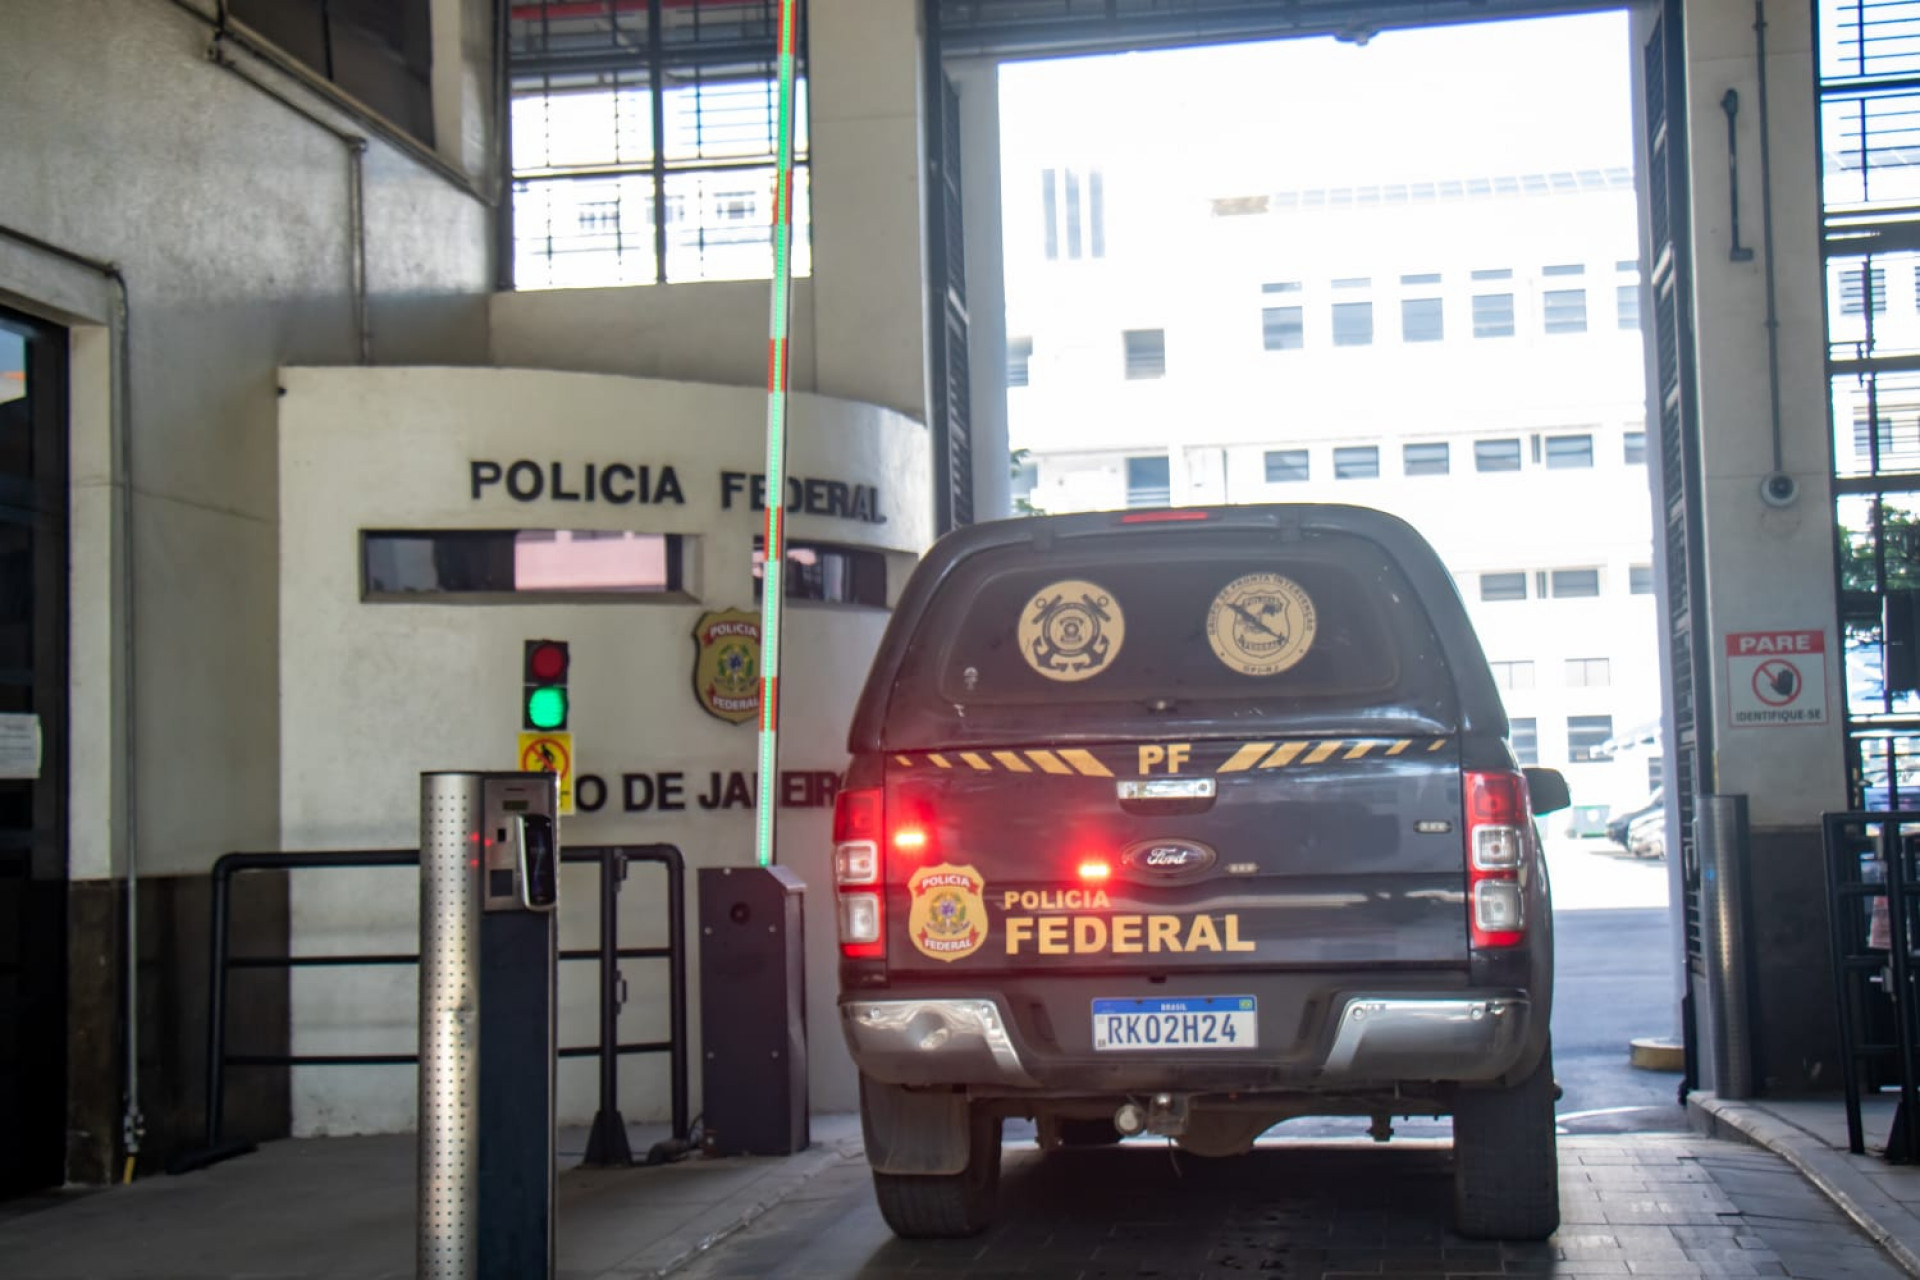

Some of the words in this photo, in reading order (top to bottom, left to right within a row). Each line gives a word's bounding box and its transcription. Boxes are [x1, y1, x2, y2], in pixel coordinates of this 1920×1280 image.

[470, 460, 686, 504] POLICIA
[1739, 634, 1811, 653] PARE
[1736, 708, 1822, 722] IDENTIFIQUE-SE
[1138, 743, 1191, 775] PF
[622, 772, 686, 812] DE
[1147, 847, 1188, 865] Ford
[922, 874, 971, 889] POLICIA
[1004, 890, 1111, 910] POLICIA
[1005, 914, 1256, 955] FEDERAL
[924, 938, 972, 951] FEDERAL
